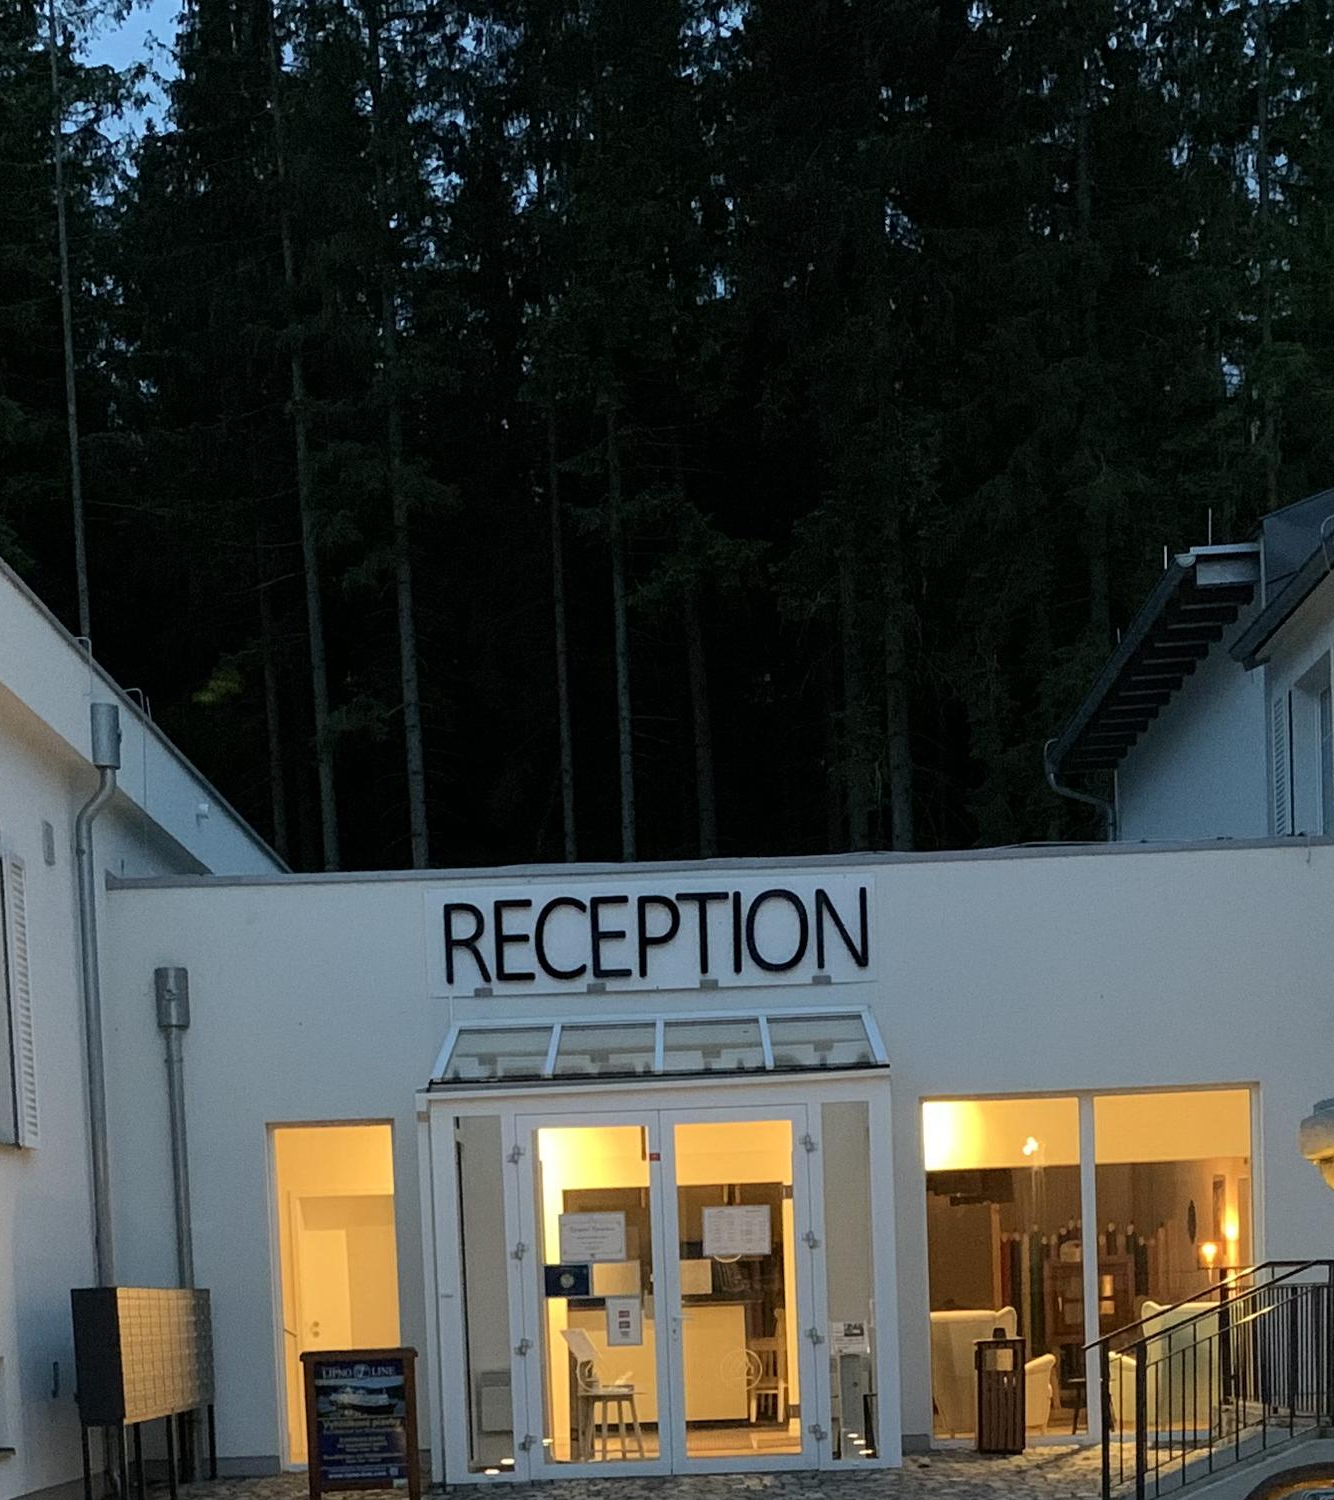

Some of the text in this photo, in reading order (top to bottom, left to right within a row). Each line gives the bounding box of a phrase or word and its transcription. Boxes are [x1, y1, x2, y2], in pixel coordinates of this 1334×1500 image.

[443, 886, 869, 985] RECEPTION
[322, 1366, 395, 1378] LIPNO LINE
